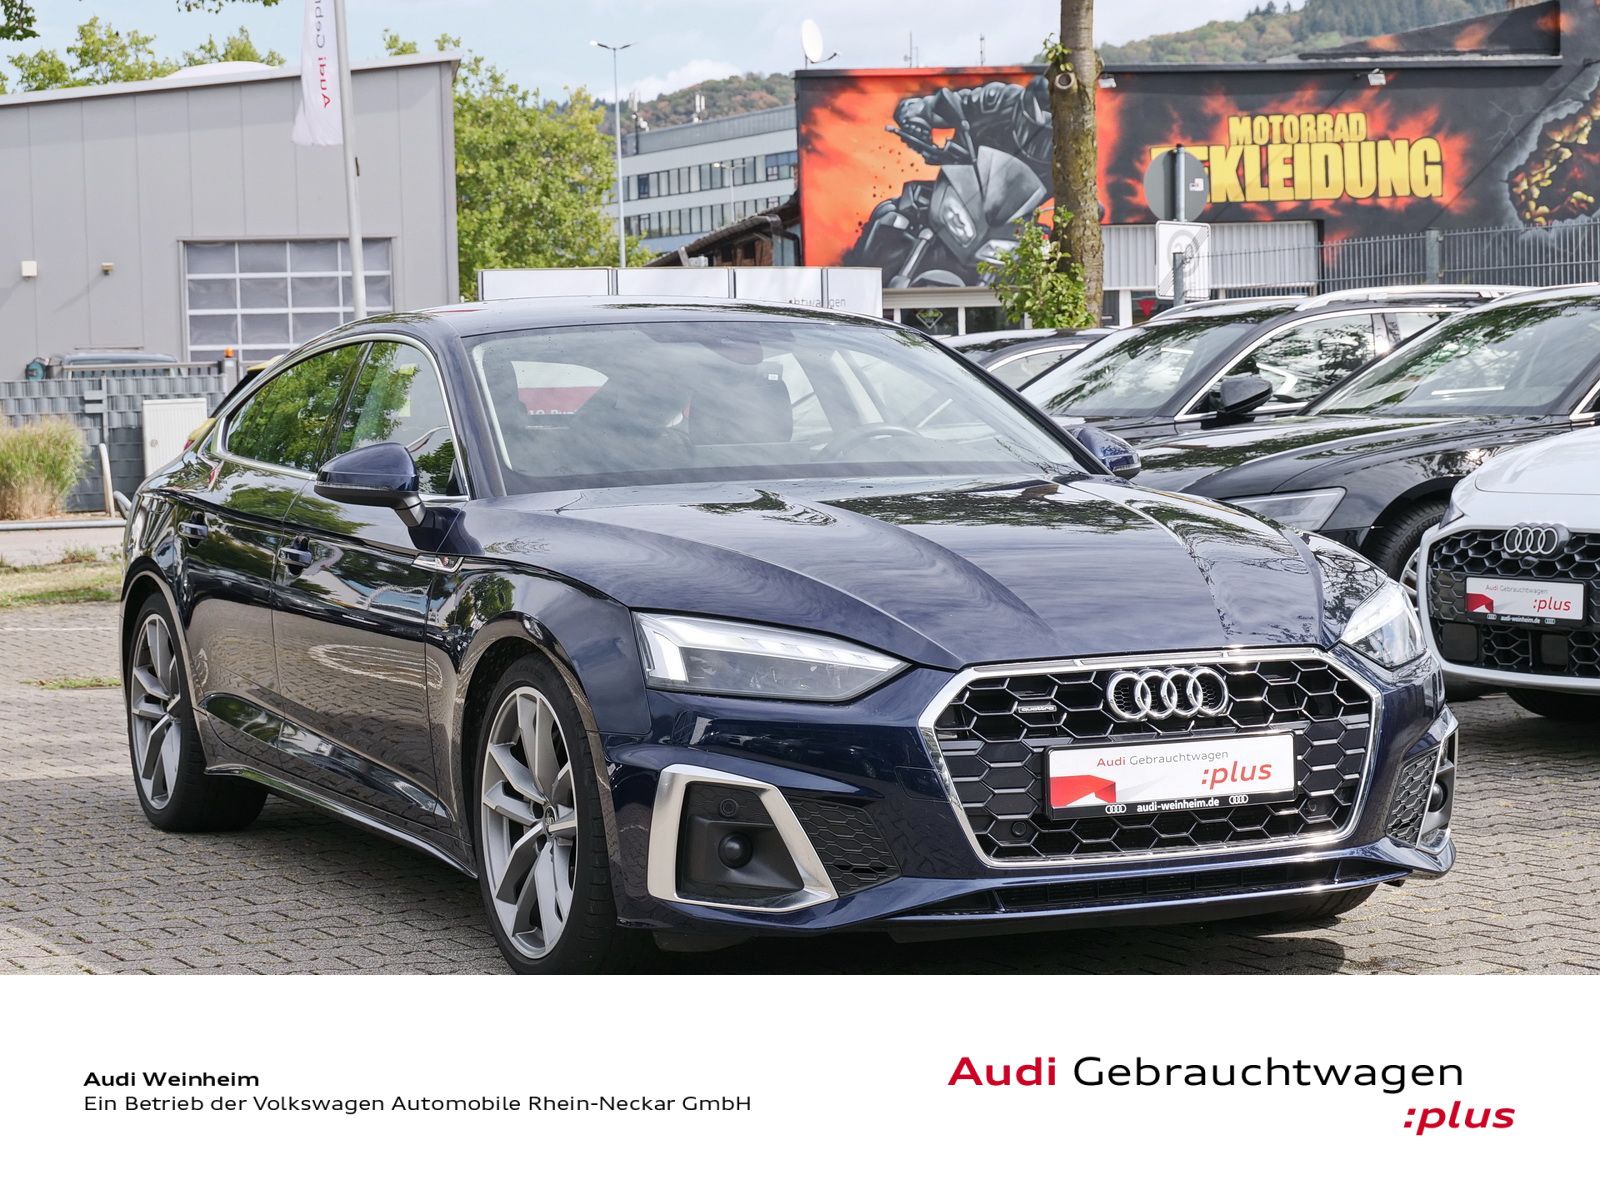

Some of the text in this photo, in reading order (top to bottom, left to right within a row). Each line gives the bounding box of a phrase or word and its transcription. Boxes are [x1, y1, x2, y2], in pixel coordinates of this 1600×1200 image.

[1229, 112, 1367, 145] MOTORRAD
[1150, 137, 1443, 203] KLEIDUNG
[1485, 584, 1548, 595] Audi Gebrauchtwagen
[1532, 597, 1571, 612] :plus
[1500, 615, 1540, 624] audi-weinheim.de
[1096, 751, 1228, 767] Audi Gebrauchtwagen
[1201, 761, 1272, 790] :plus
[1136, 797, 1220, 812] audi-weinheim.de
